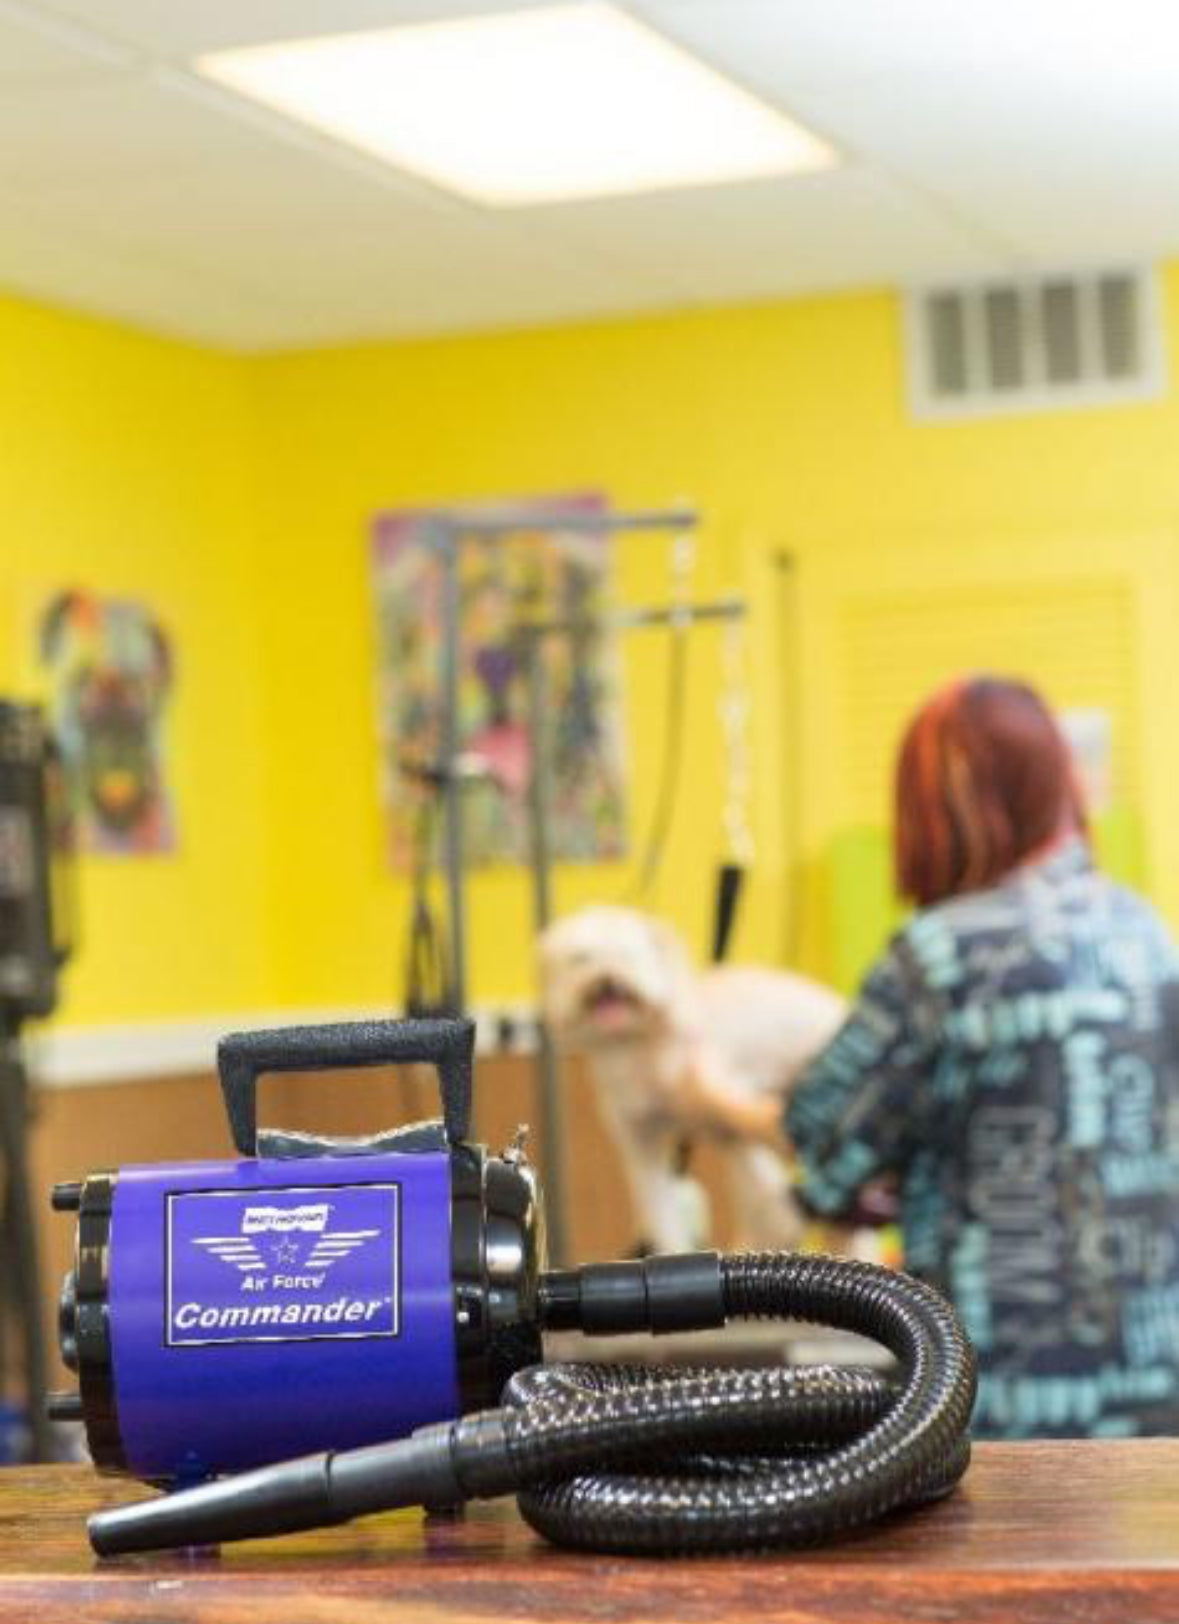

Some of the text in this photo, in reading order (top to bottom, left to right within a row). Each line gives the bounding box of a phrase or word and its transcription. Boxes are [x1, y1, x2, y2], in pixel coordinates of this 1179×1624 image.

[241, 1273, 321, 1291] Air Force
[174, 1297, 382, 1329] Commander
